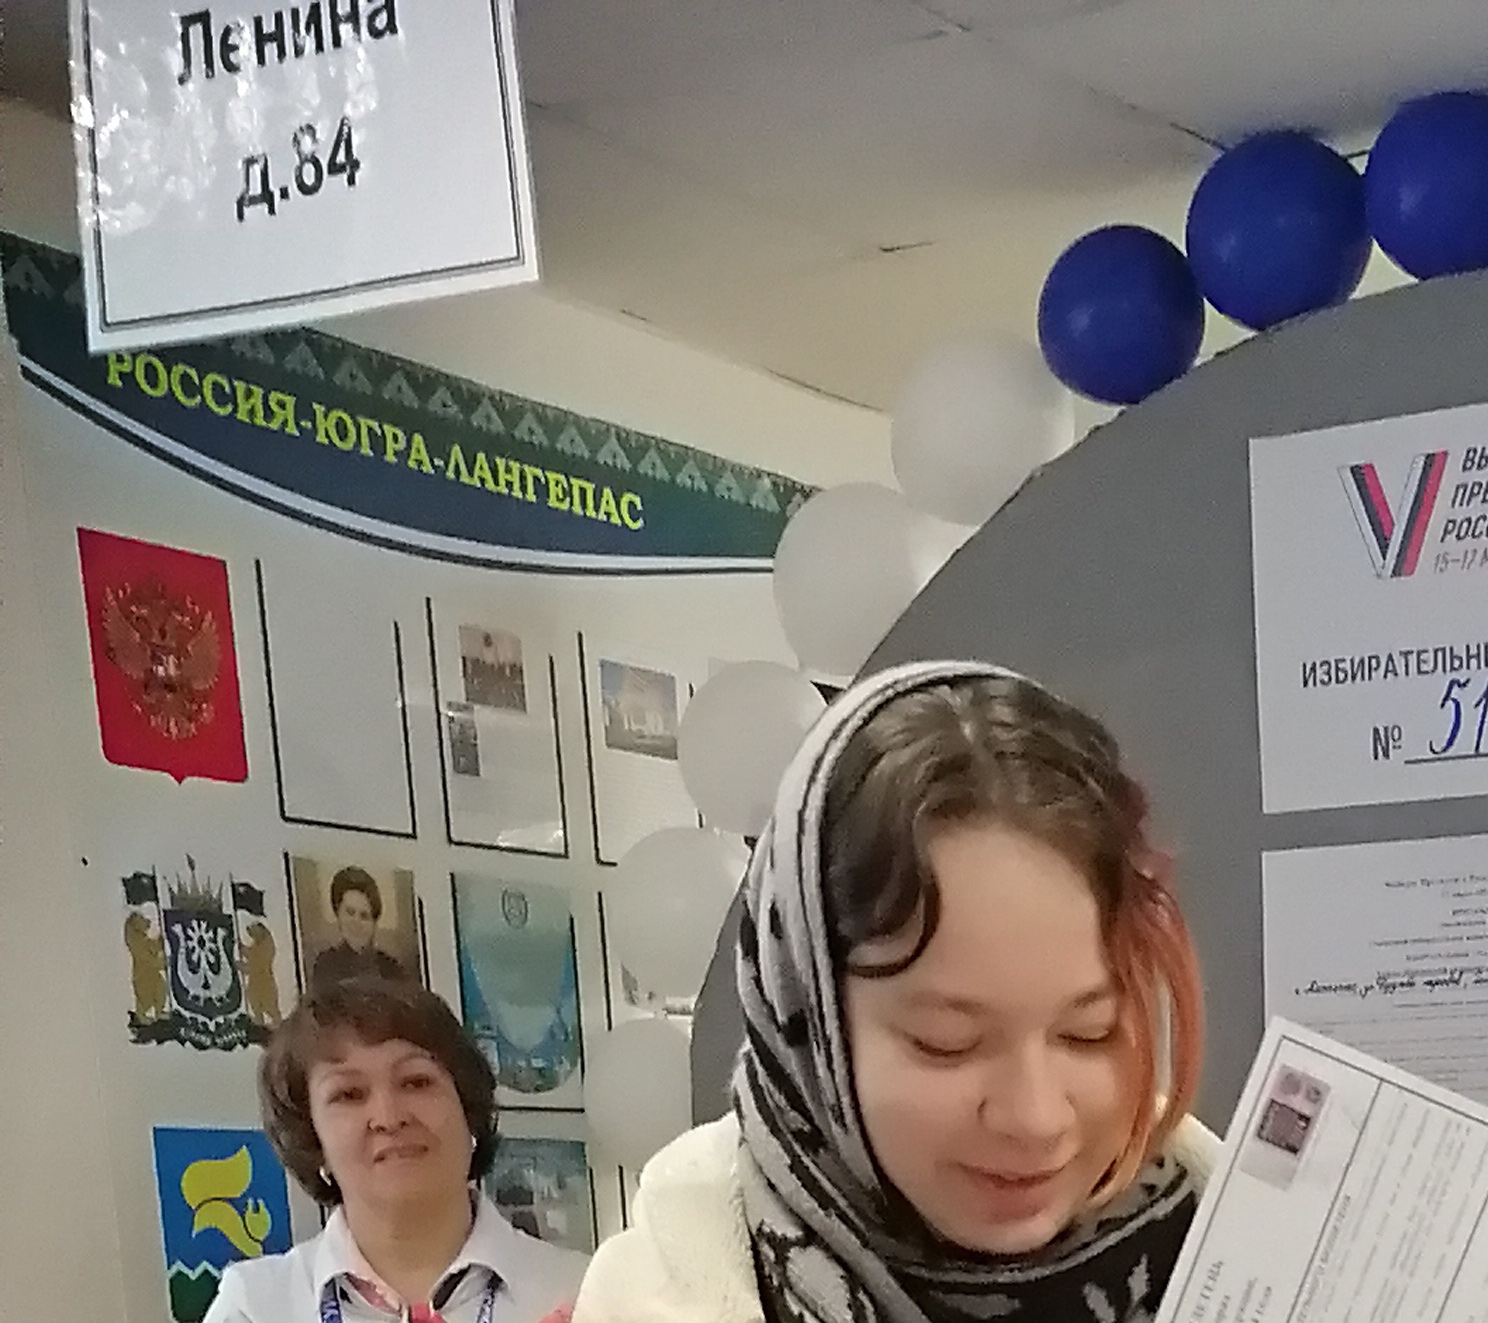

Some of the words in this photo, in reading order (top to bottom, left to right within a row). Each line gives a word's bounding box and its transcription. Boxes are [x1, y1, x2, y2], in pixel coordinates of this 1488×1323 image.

[177, 0, 399, 87] Ленина
[235, 115, 362, 223] д.84
[105, 351, 645, 532] РОССИЯ-ЮГРА-ЛАНГЕПАС
